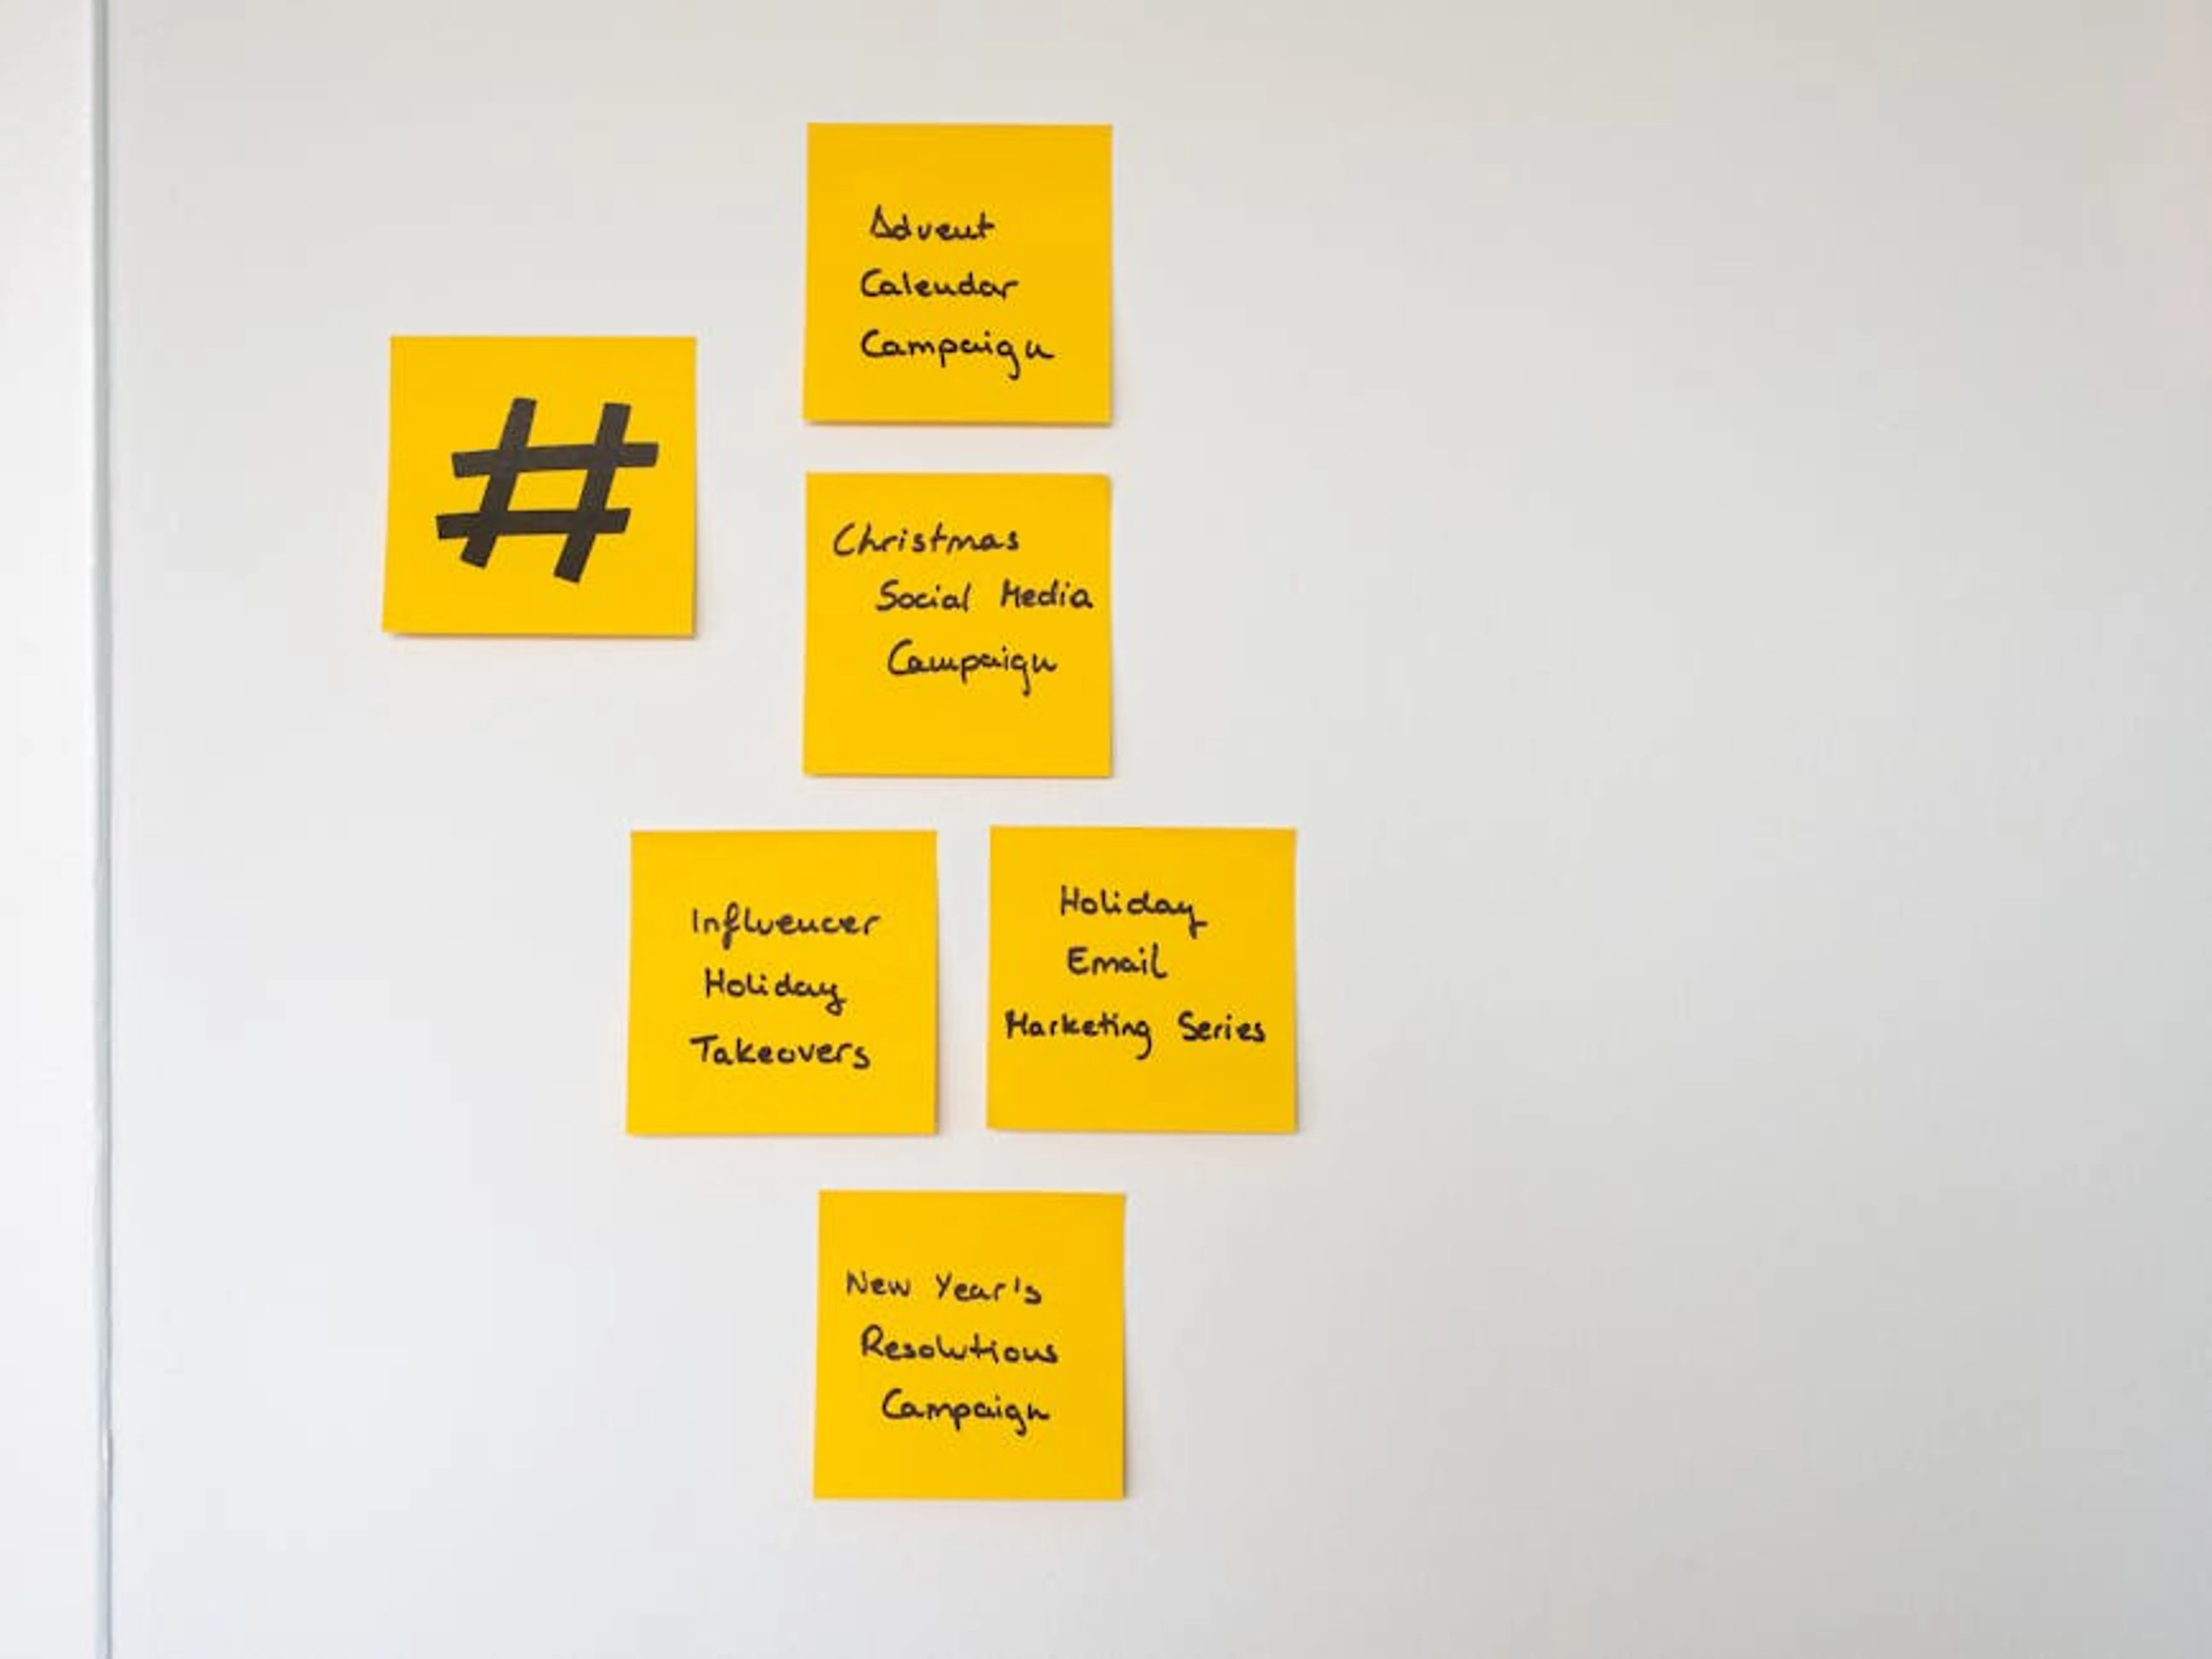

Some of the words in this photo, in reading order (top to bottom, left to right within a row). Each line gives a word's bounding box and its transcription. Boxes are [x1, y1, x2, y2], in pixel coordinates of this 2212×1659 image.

[870, 204, 995, 242] Advent
[861, 268, 1019, 299] Calendar
[861, 328, 1055, 381] Campaign
[435, 397, 659, 584] #
[833, 522, 1019, 557] Christmas
[876, 579, 971, 612] Social
[1000, 579, 1094, 609] Media
[887, 639, 1057, 697] Campaign
[693, 902, 879, 950] Influencer
[1060, 885, 1208, 939] Holiday
[1067, 942, 1167, 980] Email
[704, 968, 846, 1017] Holiday
[690, 1034, 870, 1070] Takeovers
[1004, 1009, 1153, 1061] Marketing
[1177, 1010, 1266, 1043] Series
[846, 1271, 910, 1297] New
[936, 1275, 1042, 1305] Year's
[861, 1324, 1058, 1364] Resolutions
[881, 1388, 1050, 1437] Campaign
